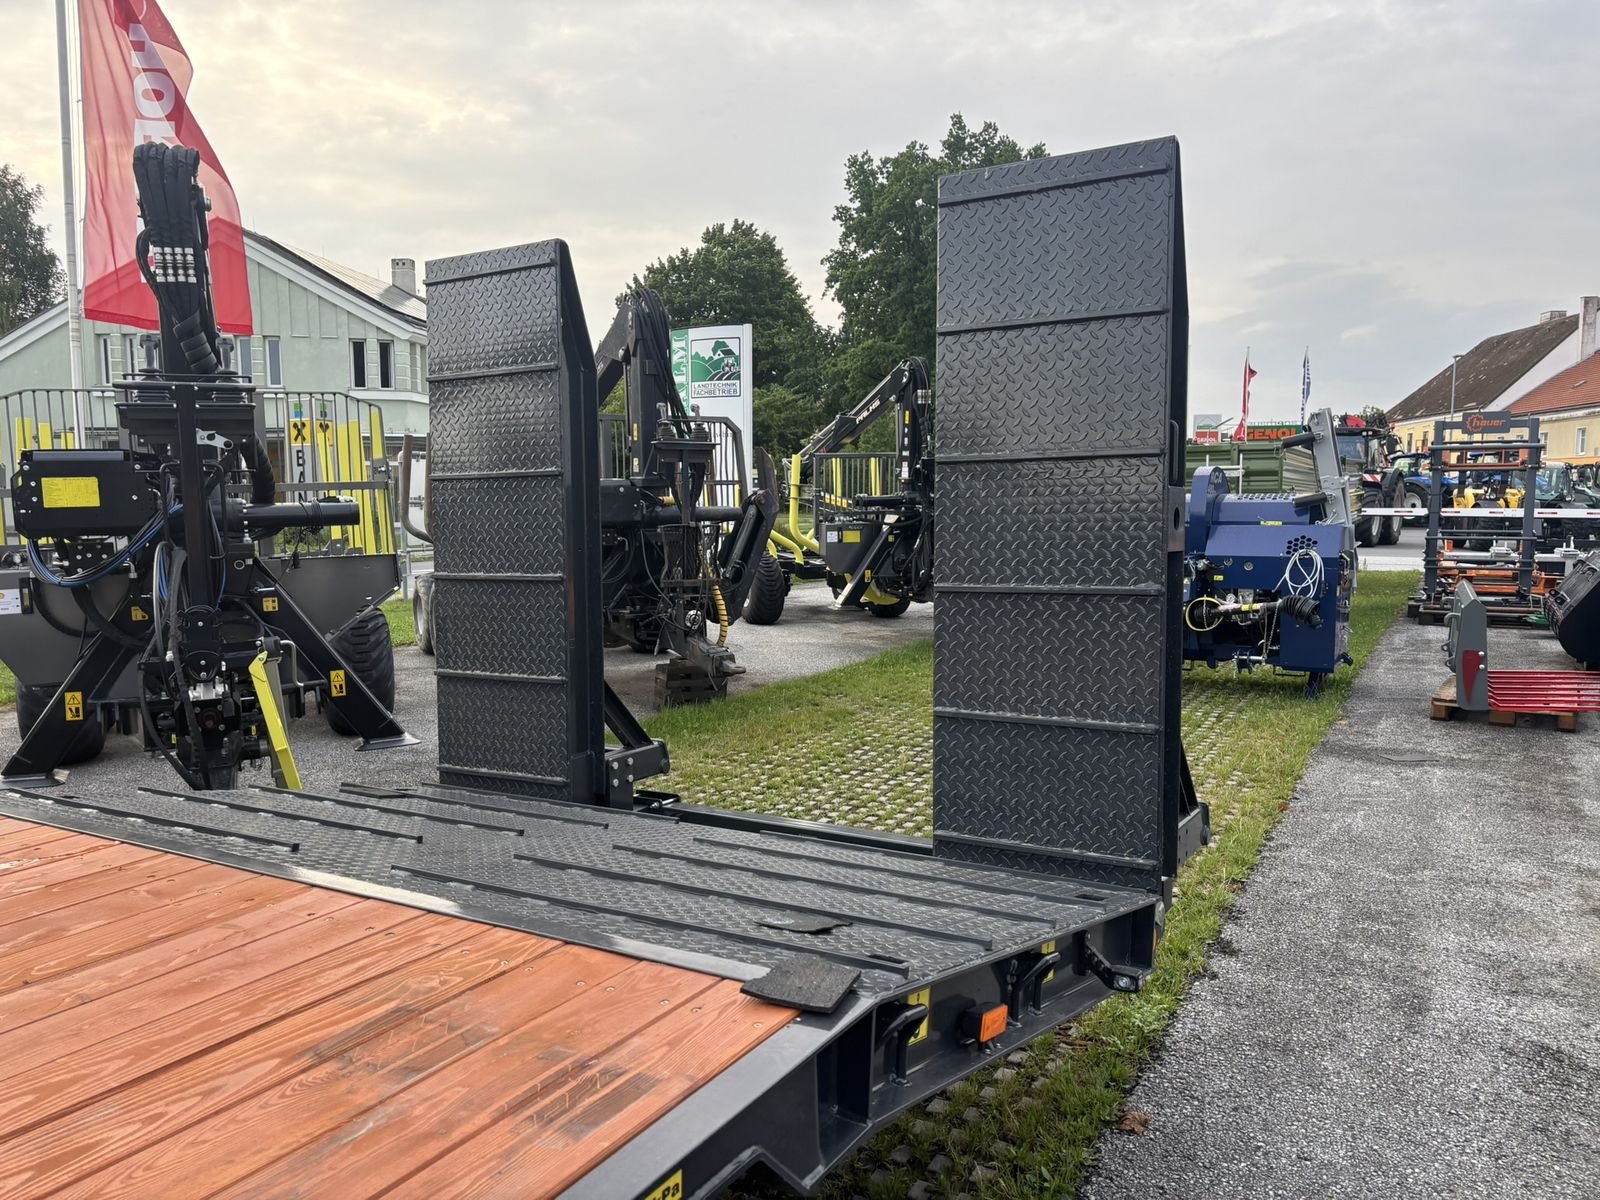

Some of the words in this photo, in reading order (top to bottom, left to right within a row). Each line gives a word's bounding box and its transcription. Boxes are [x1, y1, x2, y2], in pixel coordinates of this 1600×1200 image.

[671, 335, 688, 412] ALM
[693, 388, 738, 396] FACHBETRIEB
[651, 1182, 680, 1200] Pa
